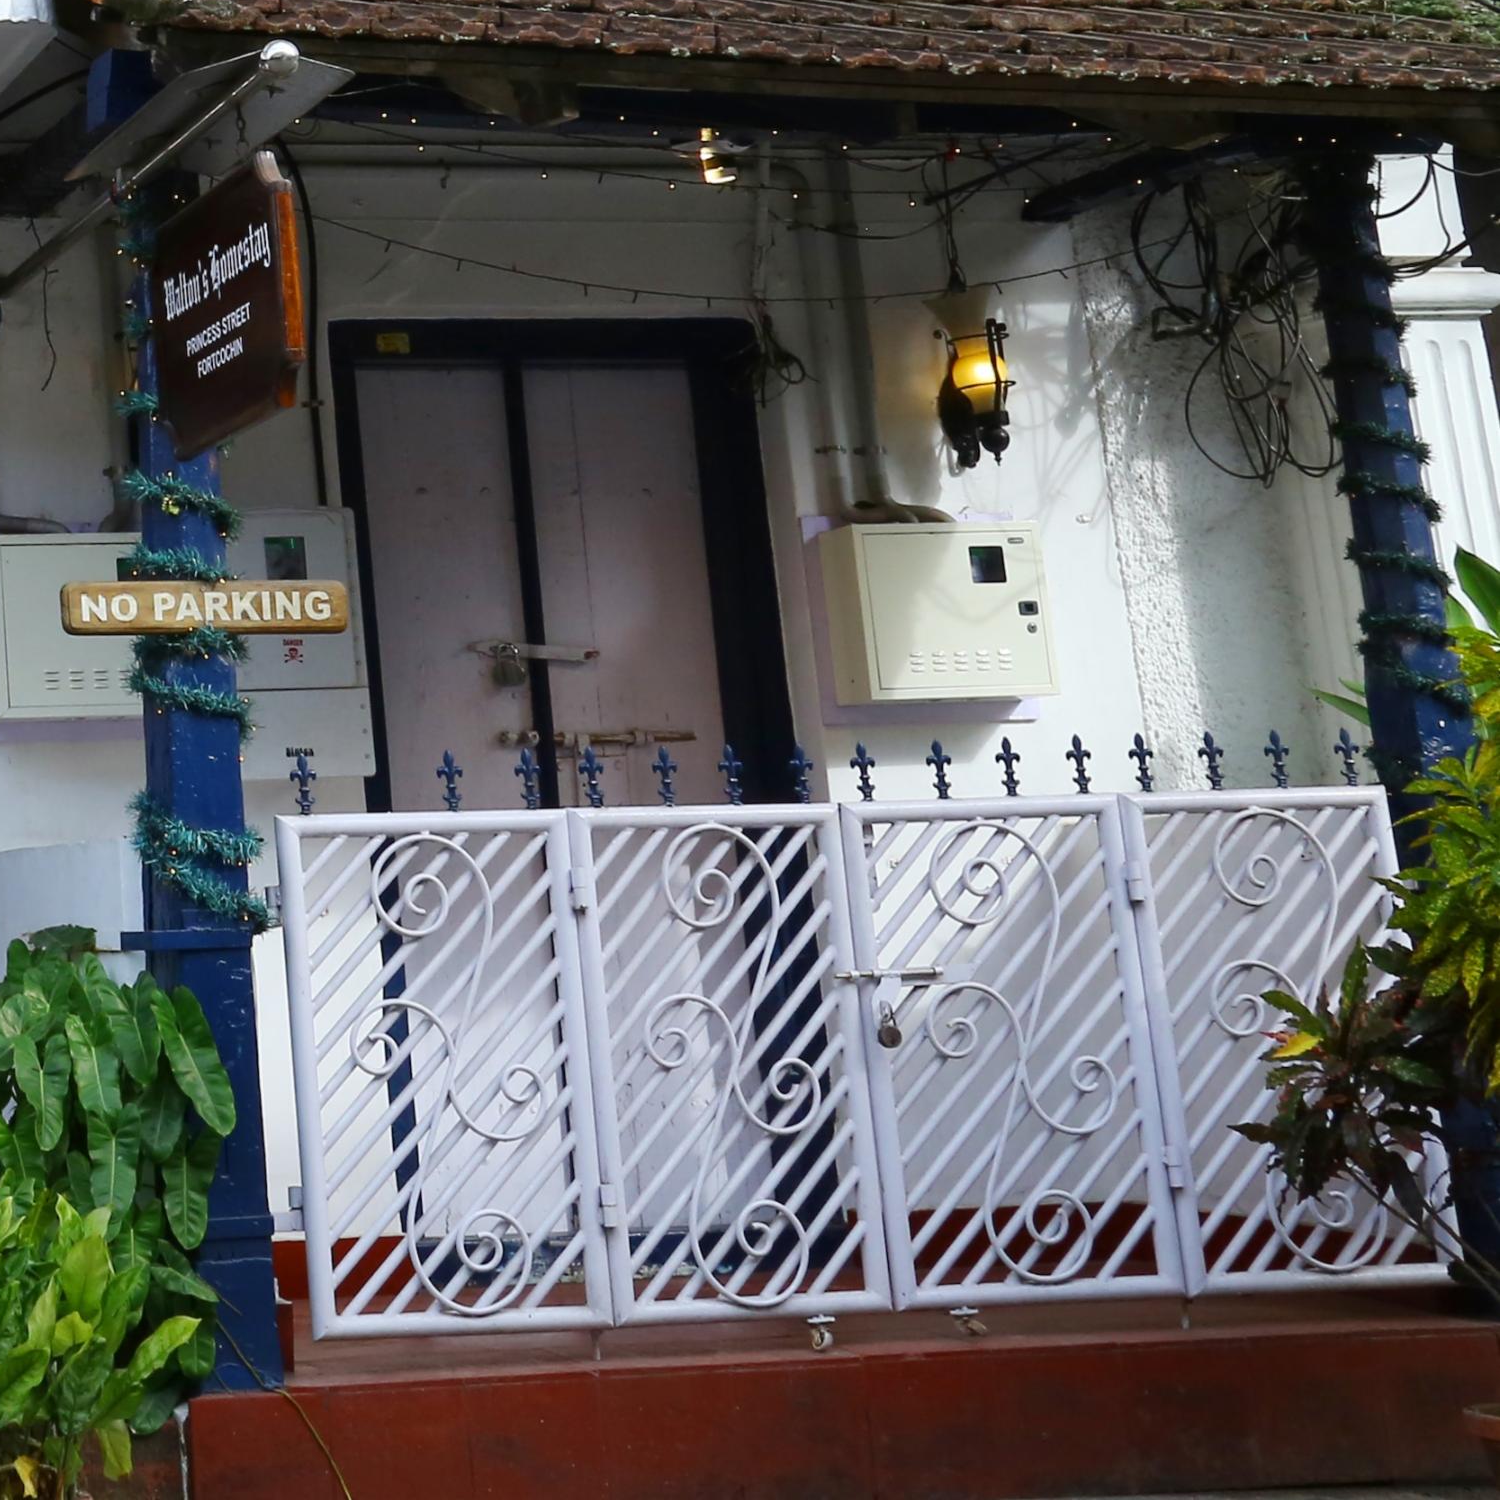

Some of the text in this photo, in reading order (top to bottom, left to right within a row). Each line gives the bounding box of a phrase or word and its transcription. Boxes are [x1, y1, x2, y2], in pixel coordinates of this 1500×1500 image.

[163, 221, 272, 322] Walton's Homestay
[185, 301, 251, 357] PRINCESS STREET
[196, 336, 244, 378] FORTCOCHIN
[80, 590, 333, 623] NO PARKING
